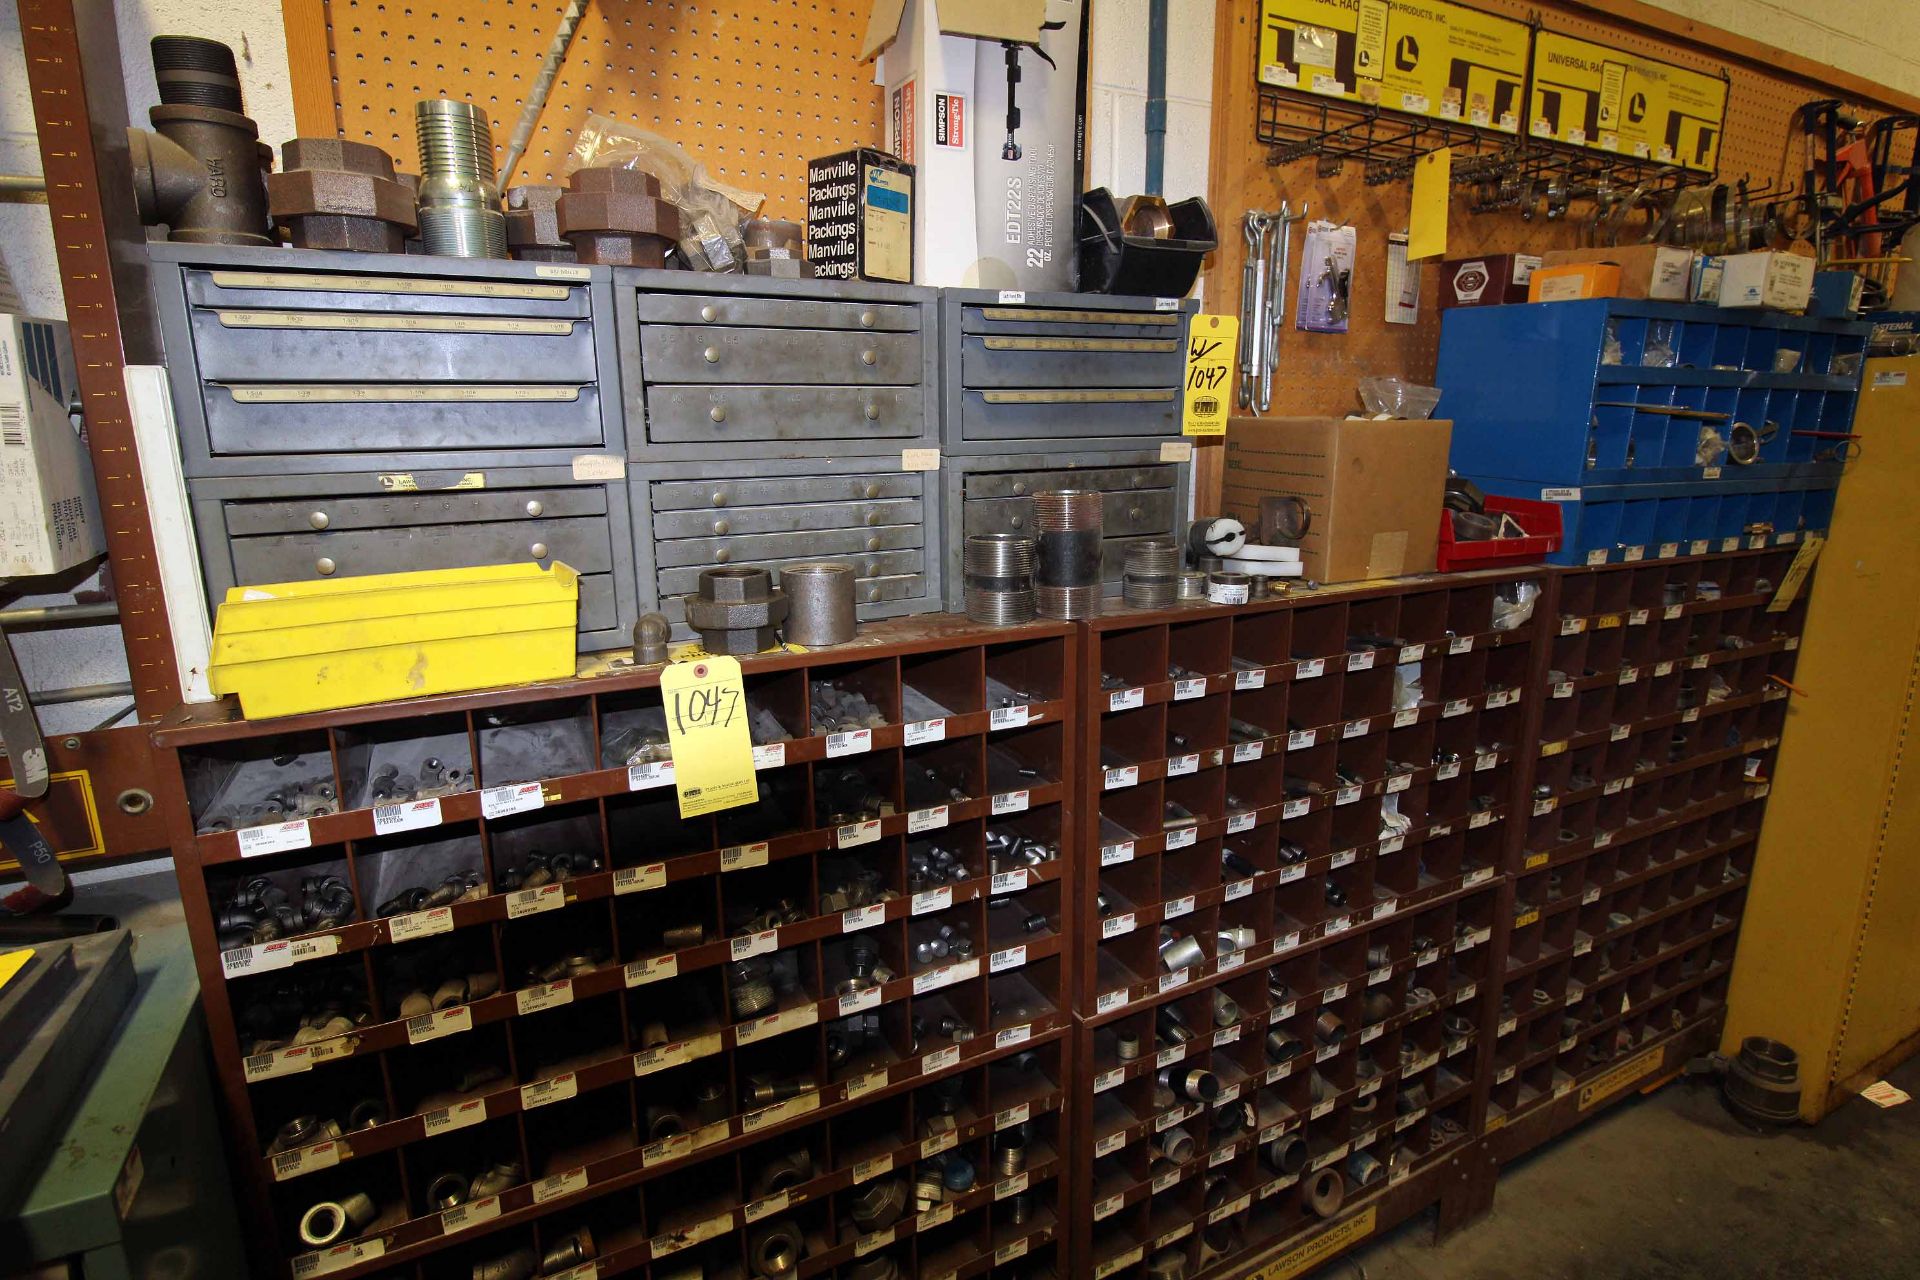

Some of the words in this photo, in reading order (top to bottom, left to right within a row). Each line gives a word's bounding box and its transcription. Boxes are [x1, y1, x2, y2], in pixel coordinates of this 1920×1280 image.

[1548, 52, 1588, 72] UNIVERSAL
[938, 98, 946, 142] SIMPSON
[809, 161, 856, 183] Manville
[809, 183, 856, 202] Packings
[809, 201, 856, 221] Manville
[1007, 177, 1022, 244] EDT22S
[809, 222, 856, 240] Packings
[809, 240, 855, 259] Manville
[1027, 248, 1044, 269] 22
[815, 261, 855, 279] ackings
[1187, 365, 1228, 391] 1047
[77, 496, 85, 524] HANDY
[3, 688, 24, 713] AT2
[675, 686, 740, 735] 1047
[22, 747, 48, 785] 3M
[30, 840, 51, 864] P50
[1268, 1249, 1305, 1276] LAWSON
